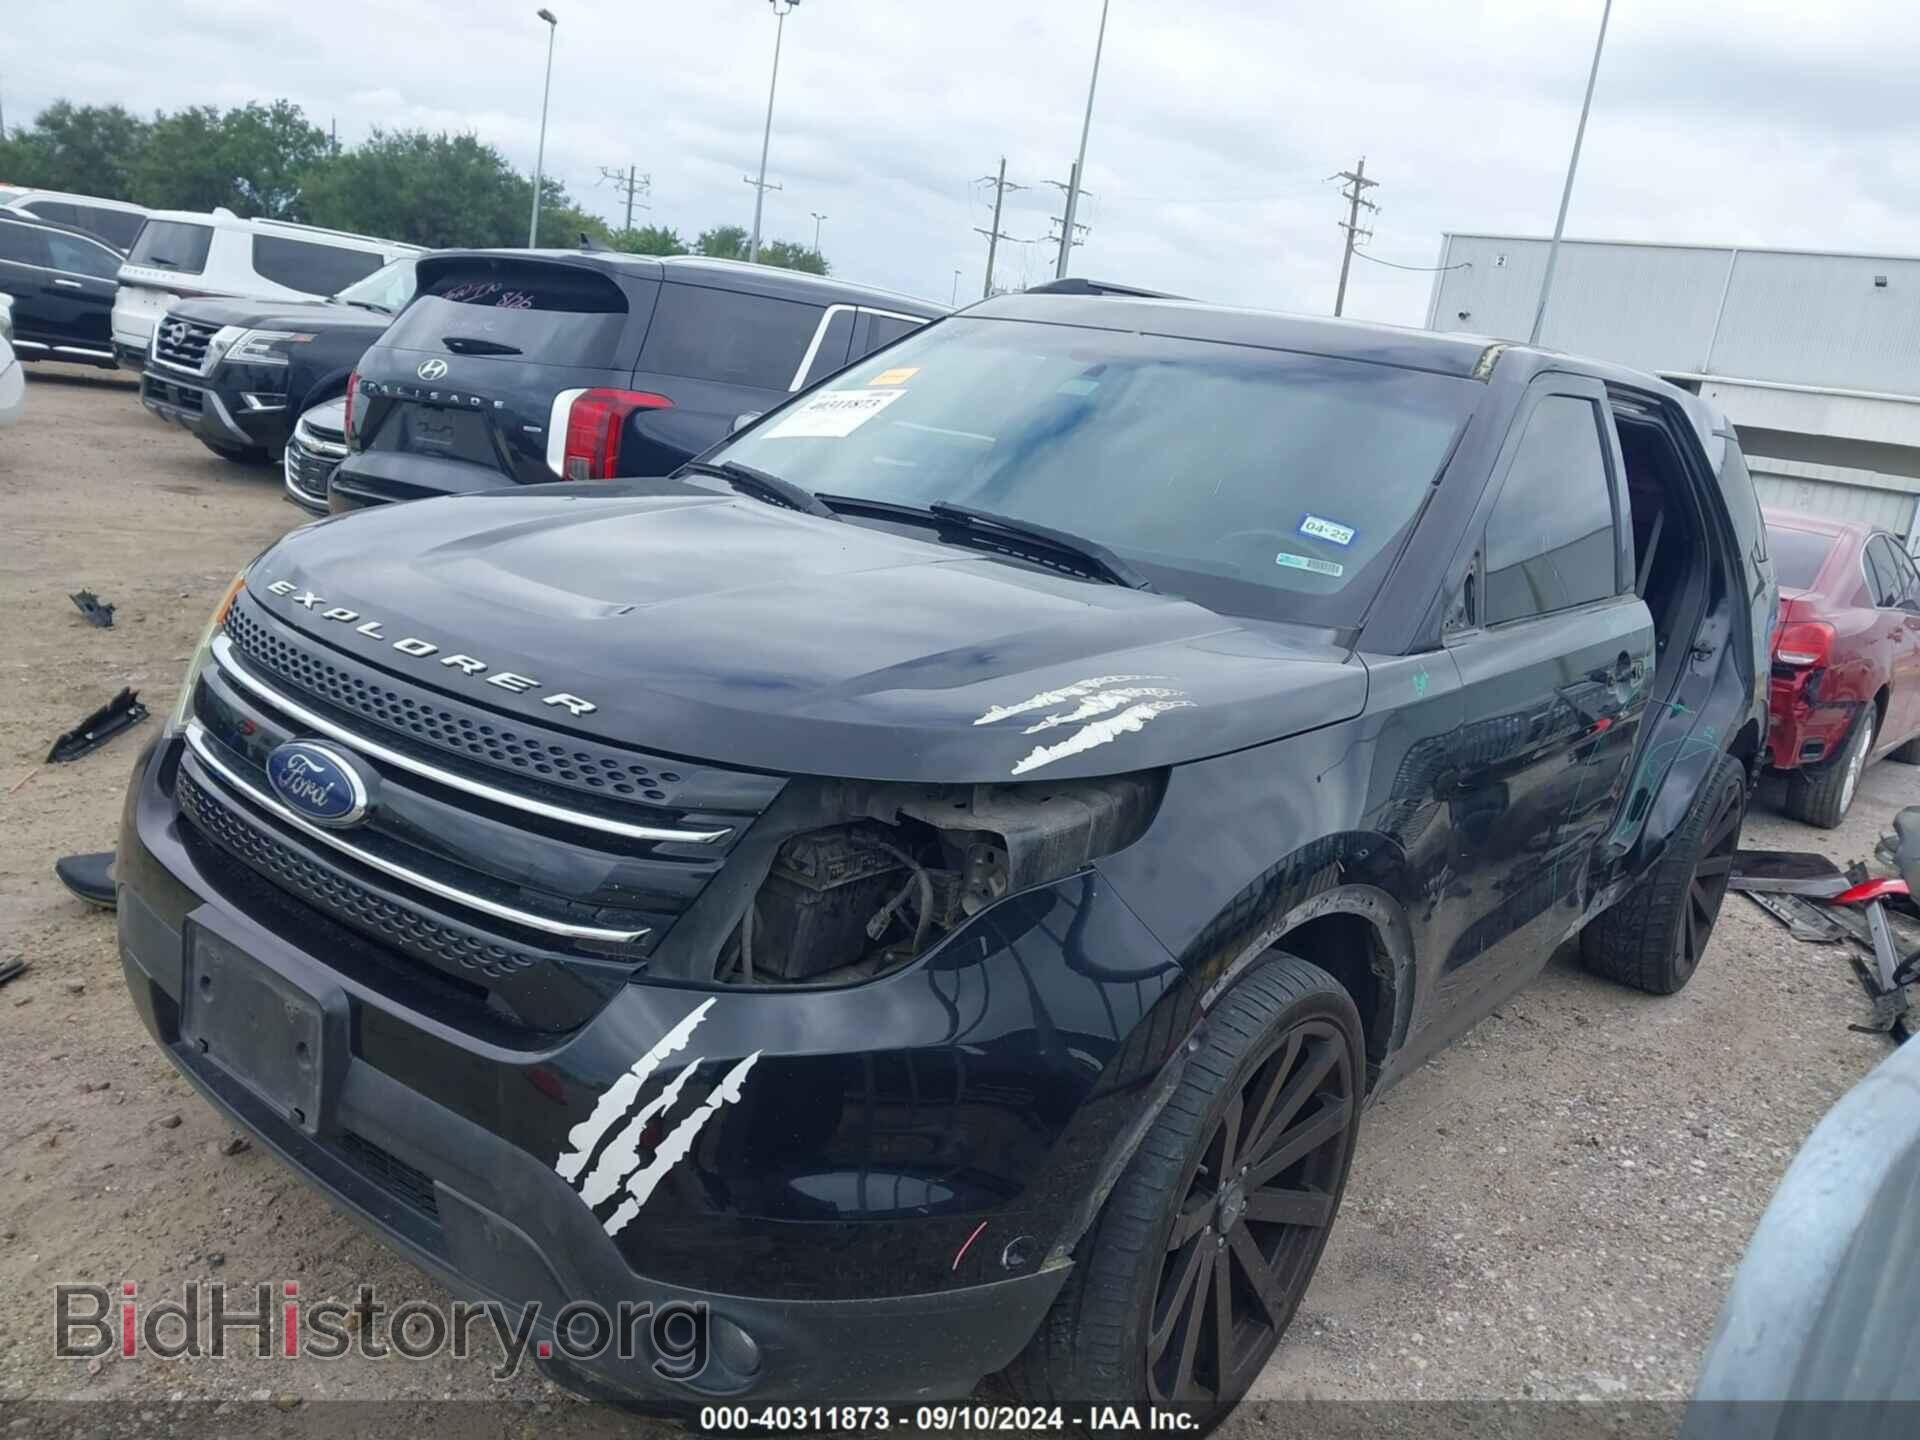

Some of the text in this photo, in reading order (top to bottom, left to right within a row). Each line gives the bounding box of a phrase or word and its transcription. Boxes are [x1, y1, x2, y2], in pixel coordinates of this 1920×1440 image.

[1497, 256, 1505, 266] 2
[367, 381, 505, 409] PALISADE
[267, 580, 598, 718] EXPLORER
[278, 753, 336, 807] Ford
